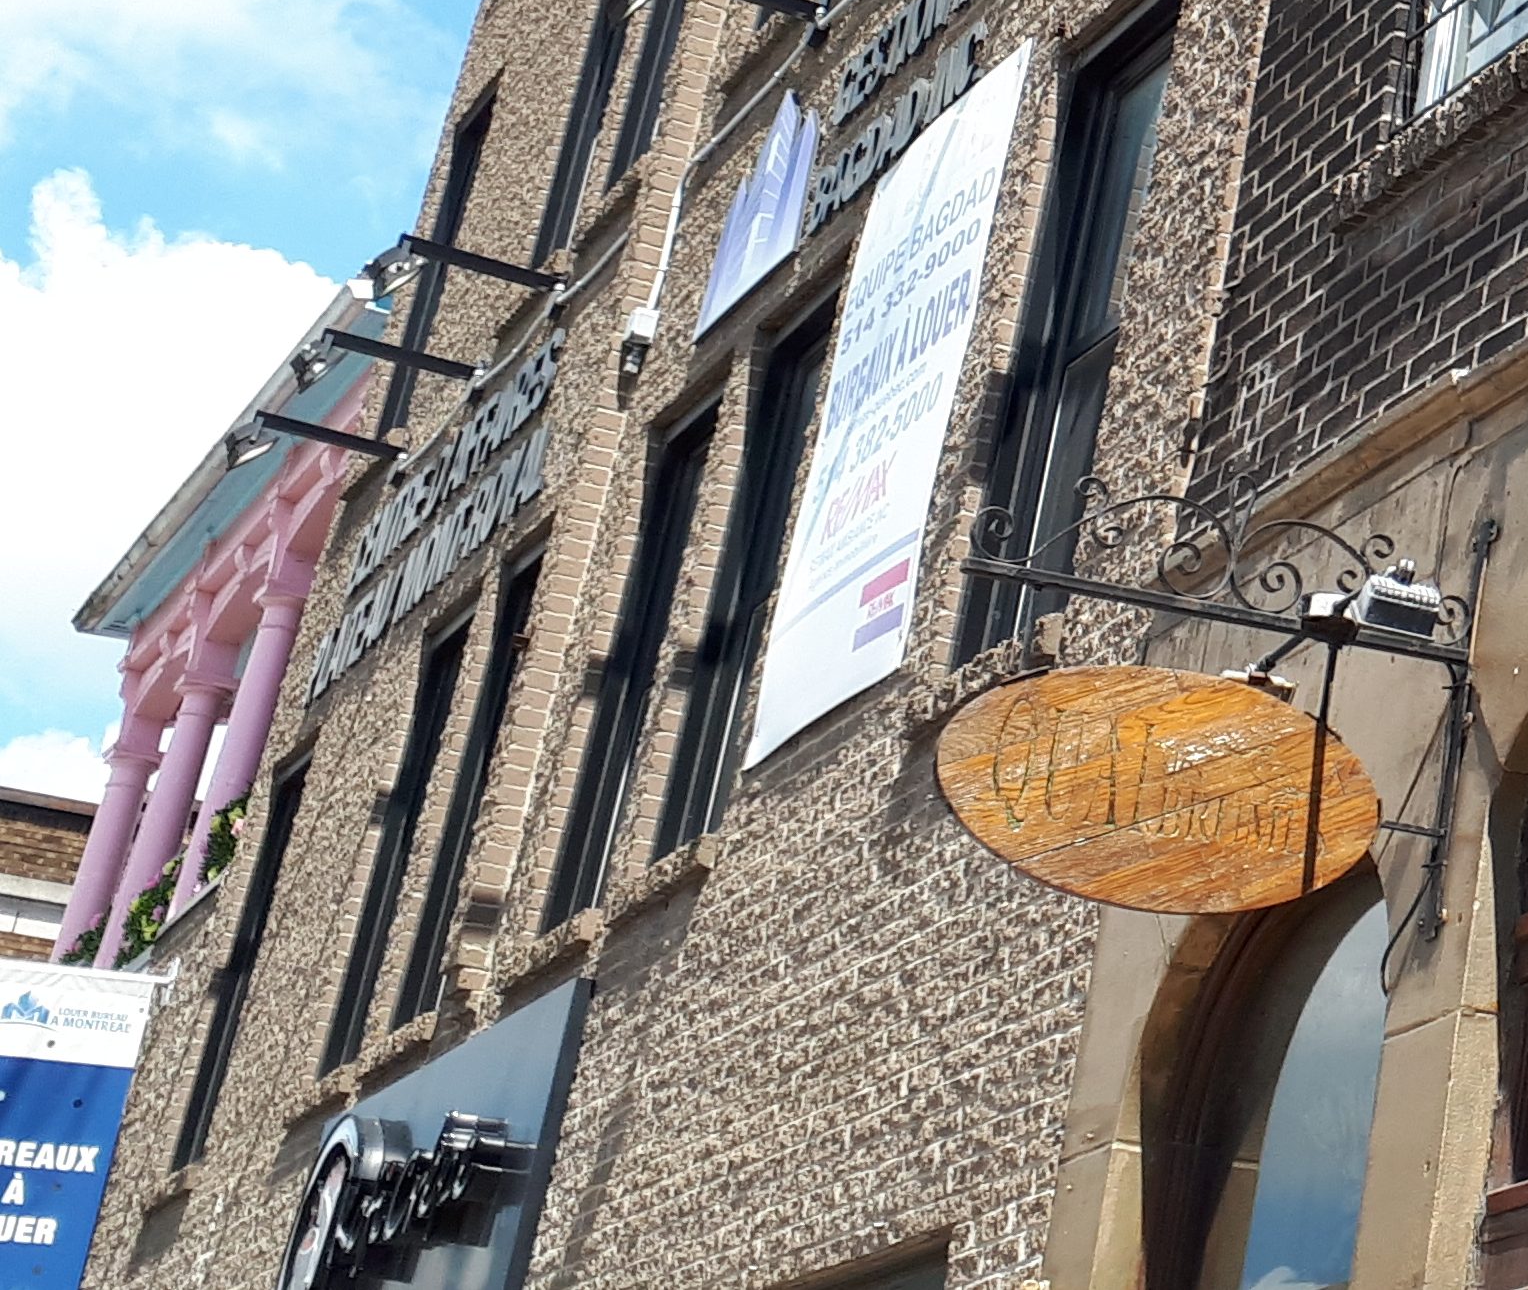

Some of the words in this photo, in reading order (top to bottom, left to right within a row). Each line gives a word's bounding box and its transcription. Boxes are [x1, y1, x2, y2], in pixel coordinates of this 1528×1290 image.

[909, 166, 996, 261] BAGDAD
[841, 307, 875, 356] 514
[881, 218, 981, 318] 332-9000
[825, 326, 899, 439] BUREAUX
[909, 268, 972, 364] LOUER
[1, 1171, 25, 1206] À
